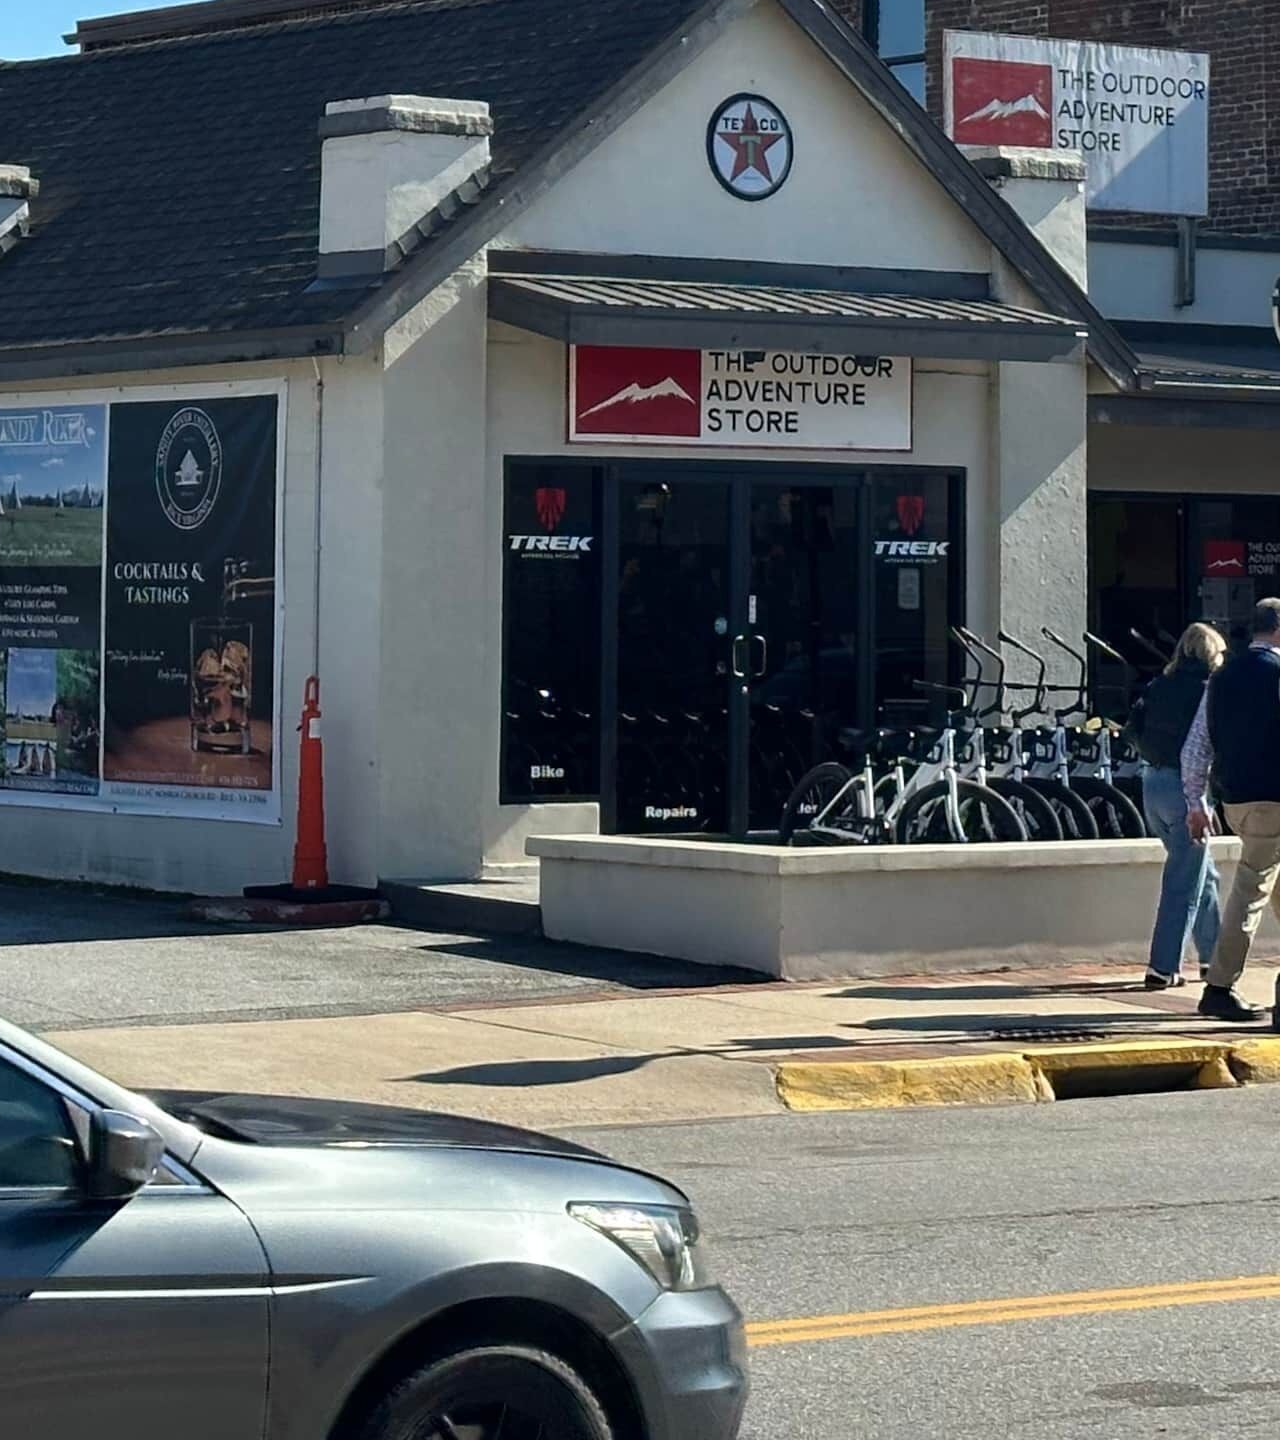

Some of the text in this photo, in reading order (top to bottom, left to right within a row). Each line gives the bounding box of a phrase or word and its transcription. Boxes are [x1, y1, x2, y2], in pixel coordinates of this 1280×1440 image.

[1057, 68, 1206, 100] THE OUTDOOR
[1057, 99, 1176, 127] ADVENTURE
[1057, 128, 1121, 152] STORE
[771, 353, 894, 378] OUTDOOR
[706, 379, 866, 405] ADVENTURE
[706, 407, 800, 433] STORE
[508, 535, 594, 551] TREK
[874, 540, 951, 556] TREK
[114, 561, 205, 582] COCKTAILS &
[124, 585, 189, 604] TASTINGS
[530, 765, 565, 779] Bike
[645, 805, 698, 820] Repairs
